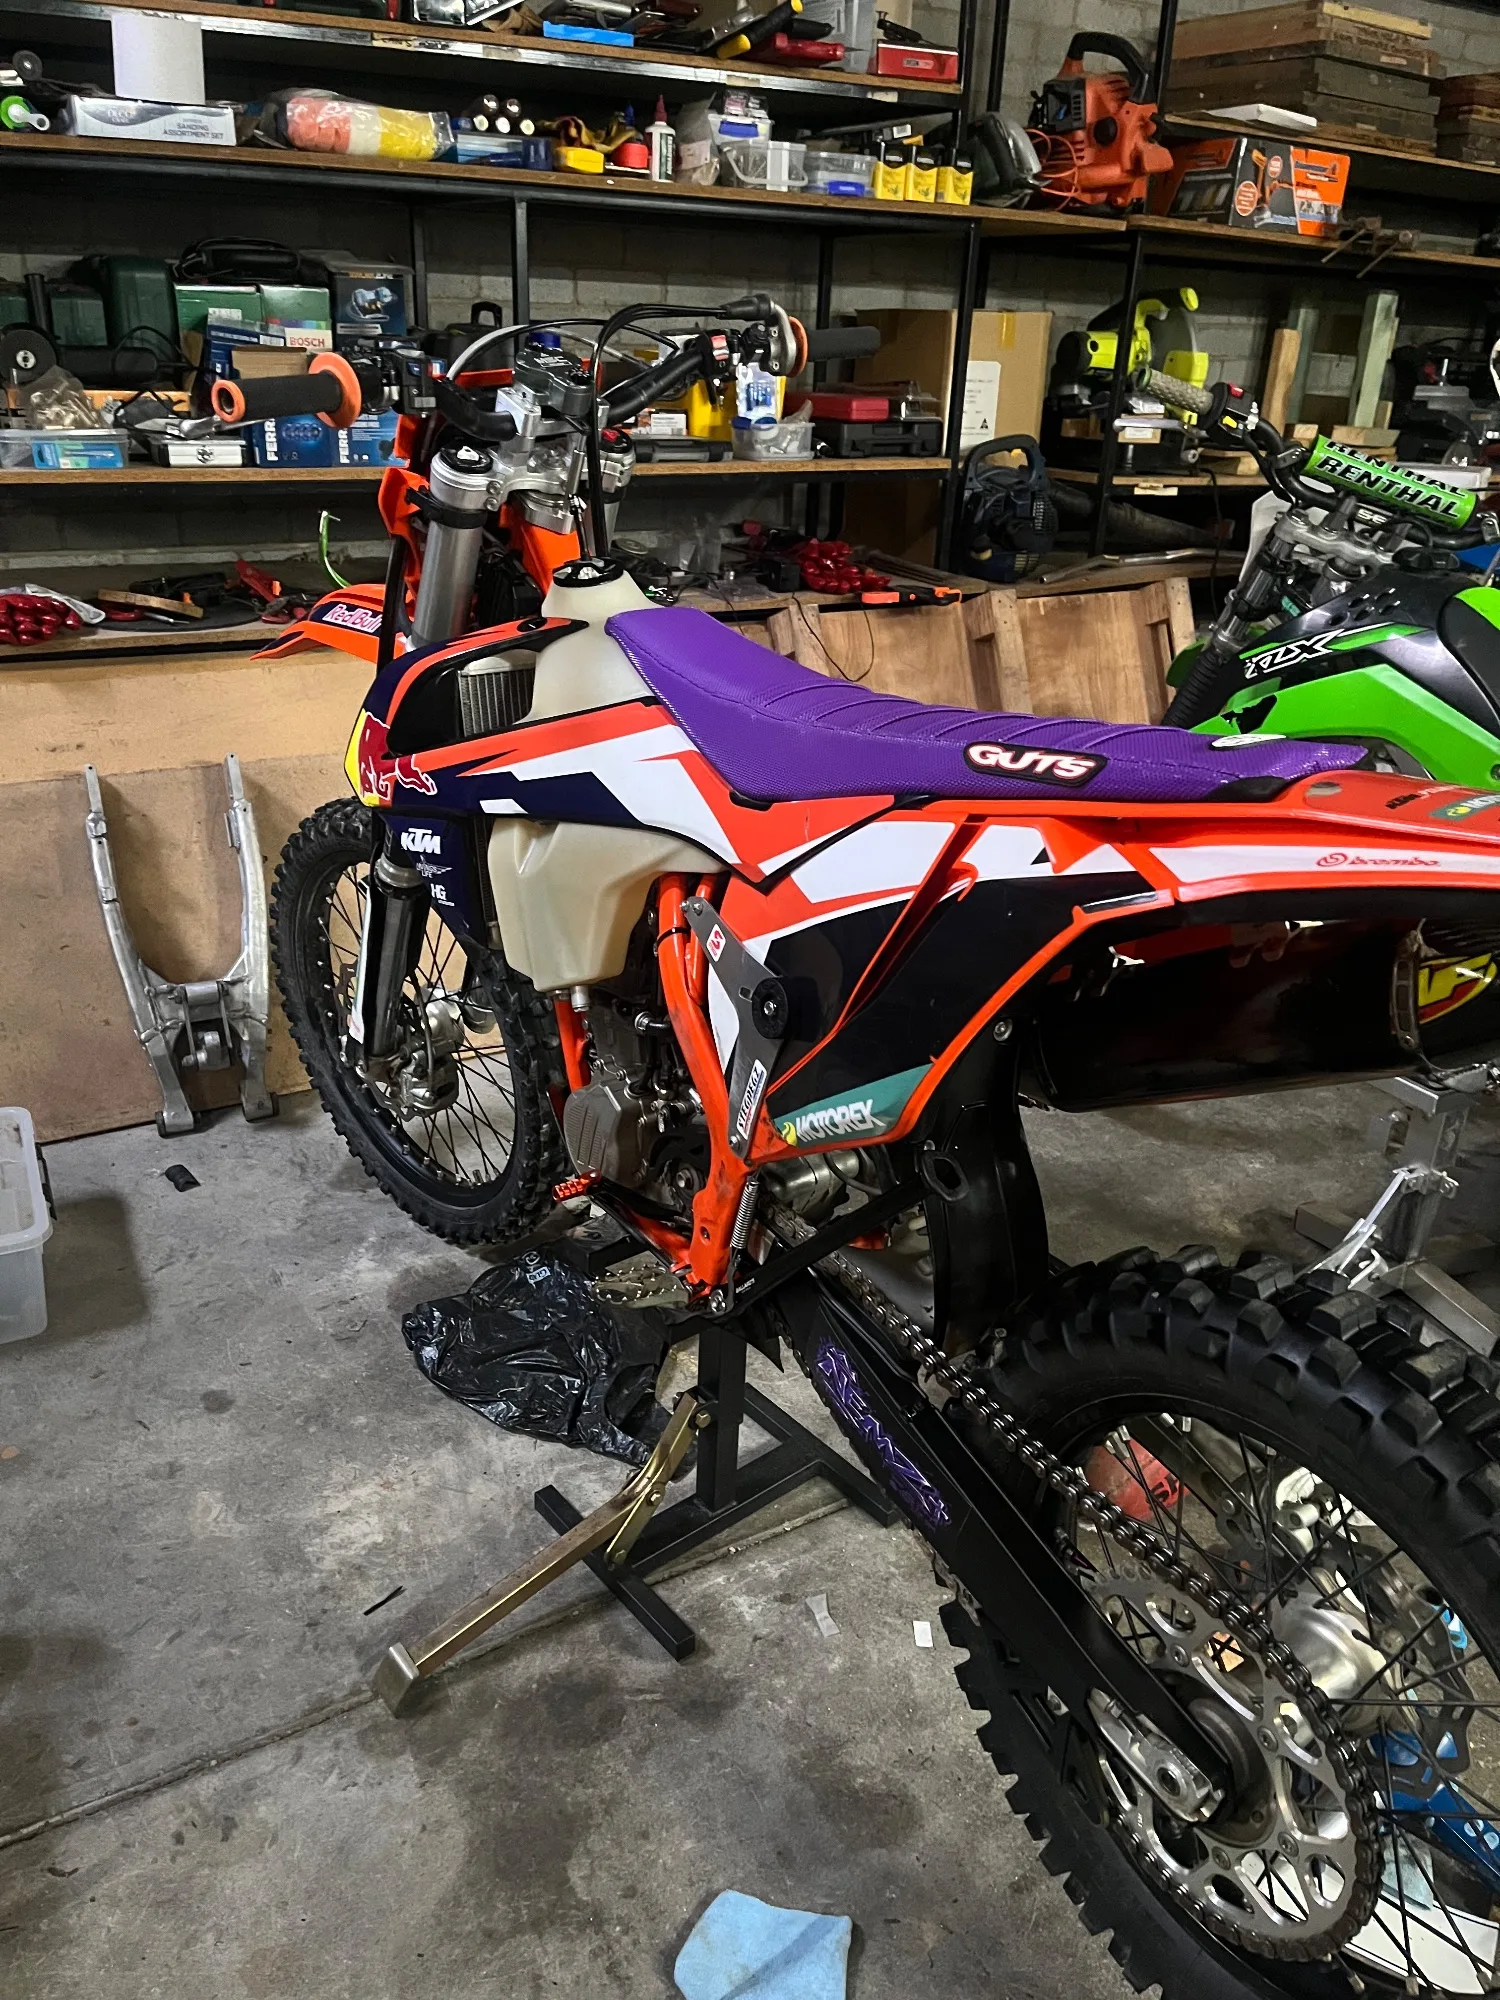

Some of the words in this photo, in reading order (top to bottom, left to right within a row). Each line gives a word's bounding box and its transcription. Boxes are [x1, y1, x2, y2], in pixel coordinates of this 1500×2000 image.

[163, 129, 209, 138] ASSORTMENT
[176, 122, 209, 131] SANDING
[290, 337, 325, 348] BOSCH
[1324, 440, 1468, 497] RENTHAL
[1315, 455, 1461, 519] RENTHAL
[968, 744, 1097, 780] GUTS
[400, 828, 441, 854] KTM
[795, 1098, 887, 1142] MOTOREX
